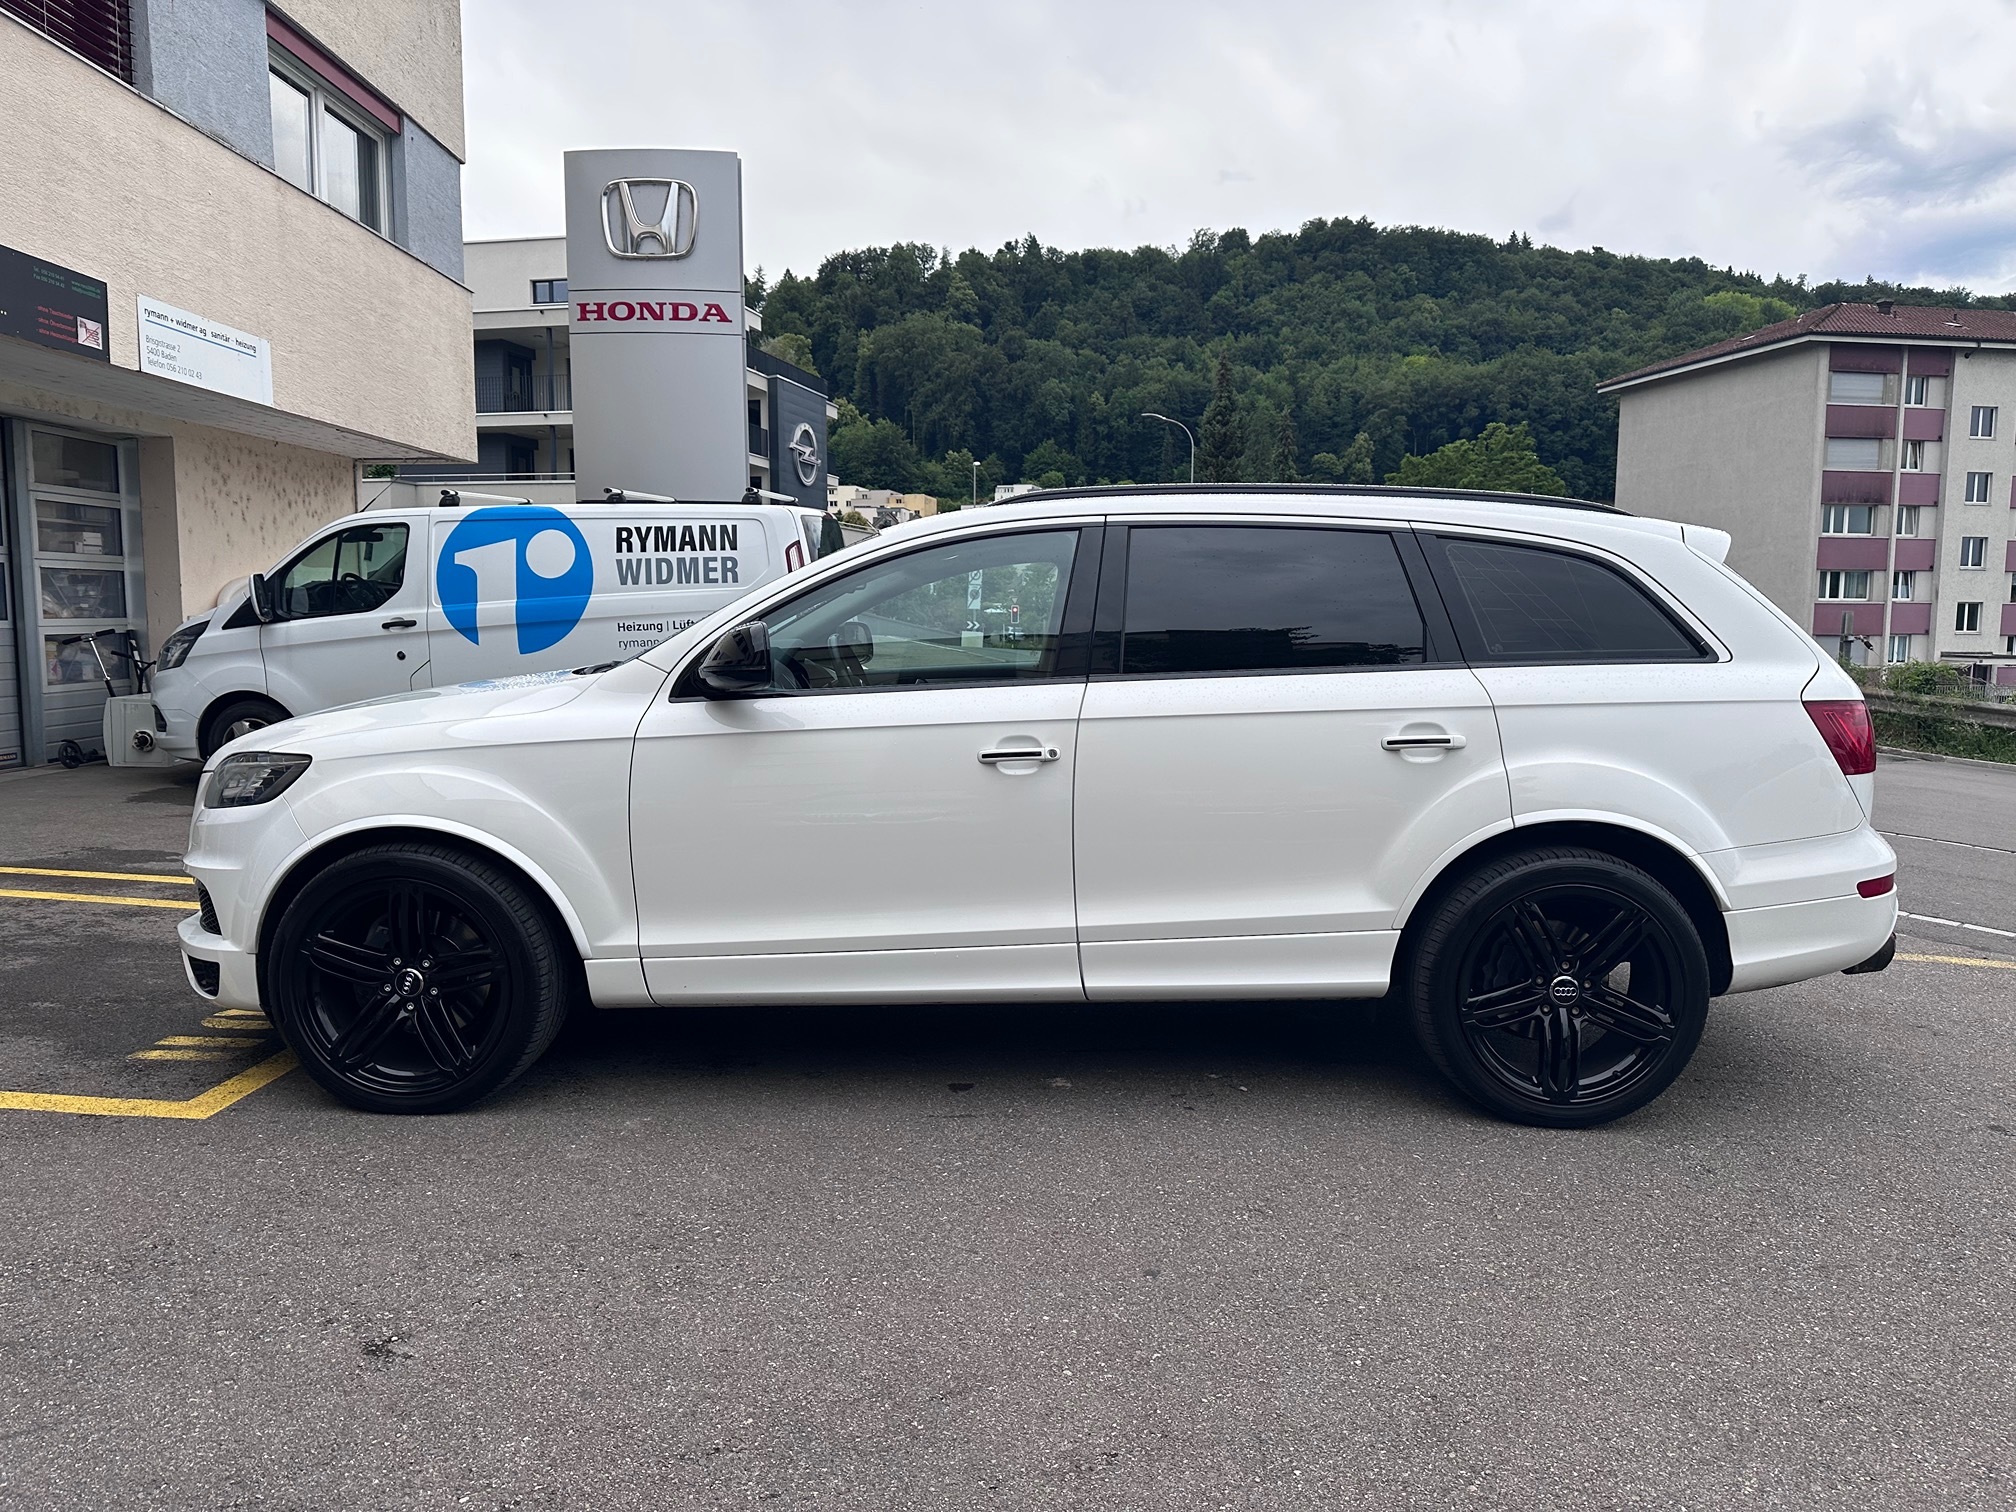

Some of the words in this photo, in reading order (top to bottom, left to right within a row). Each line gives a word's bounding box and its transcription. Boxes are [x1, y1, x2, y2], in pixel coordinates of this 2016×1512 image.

[576, 301, 732, 323] HONDA
[144, 307, 169, 322] rymann
[175, 318, 198, 333] widmer
[199, 327, 207, 337] ag
[210, 330, 230, 343] sanitär
[235, 337, 257, 354] heizung
[146, 346, 160, 357] 5400
[161, 350, 178, 362] Baden
[177, 345, 181, 353] 2
[147, 356, 166, 370] Telefon
[166, 362, 177, 373] 056
[178, 366, 187, 376] 210
[188, 369, 195, 378] 02
[195, 371, 203, 380] 43
[615, 523, 738, 554] RYMANN
[615, 556, 739, 586] WIDMER
[617, 621, 663, 633] Heizung
